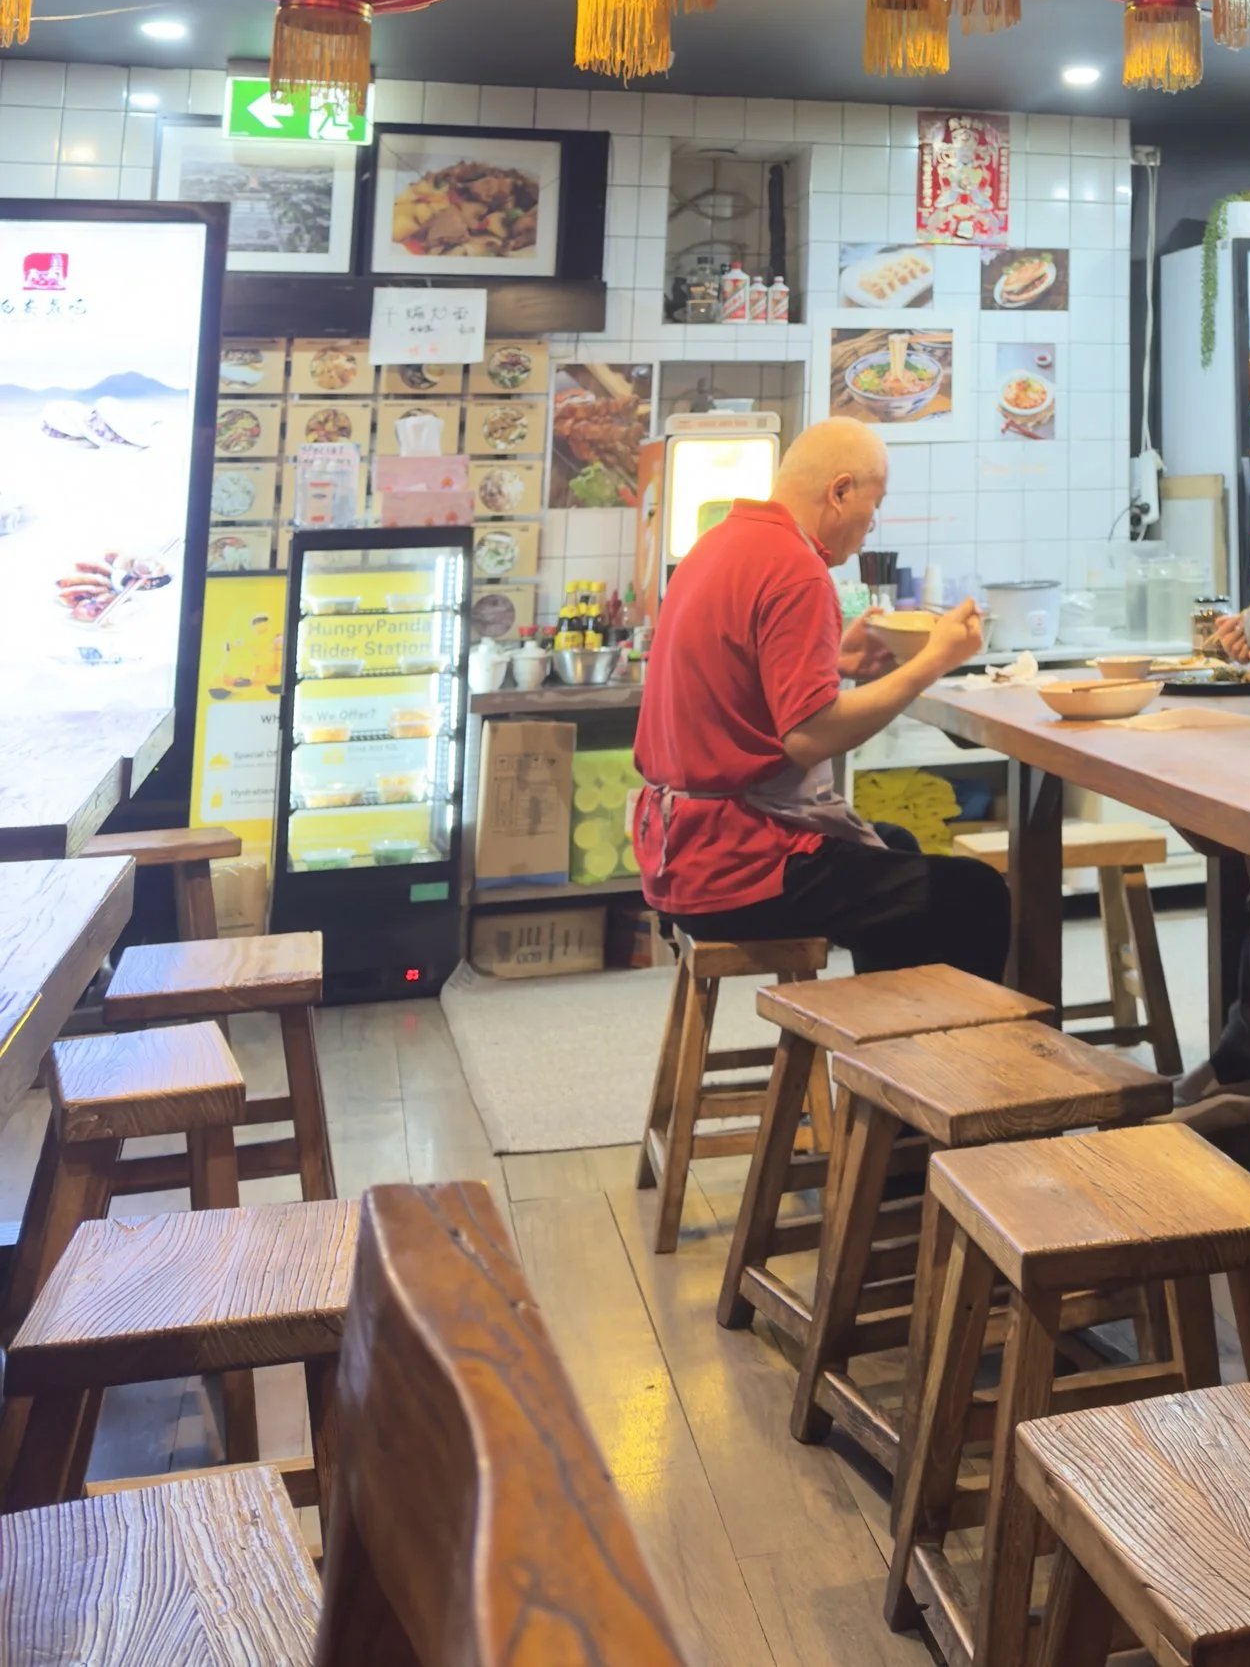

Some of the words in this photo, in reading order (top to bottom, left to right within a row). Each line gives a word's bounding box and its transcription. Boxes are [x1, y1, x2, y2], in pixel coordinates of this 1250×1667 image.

[309, 618, 431, 639] HungryPanda
[310, 642, 357, 659] Rider
[364, 640, 432, 657] Station
[317, 709, 337, 722] We
[339, 708, 376, 721] Offer?
